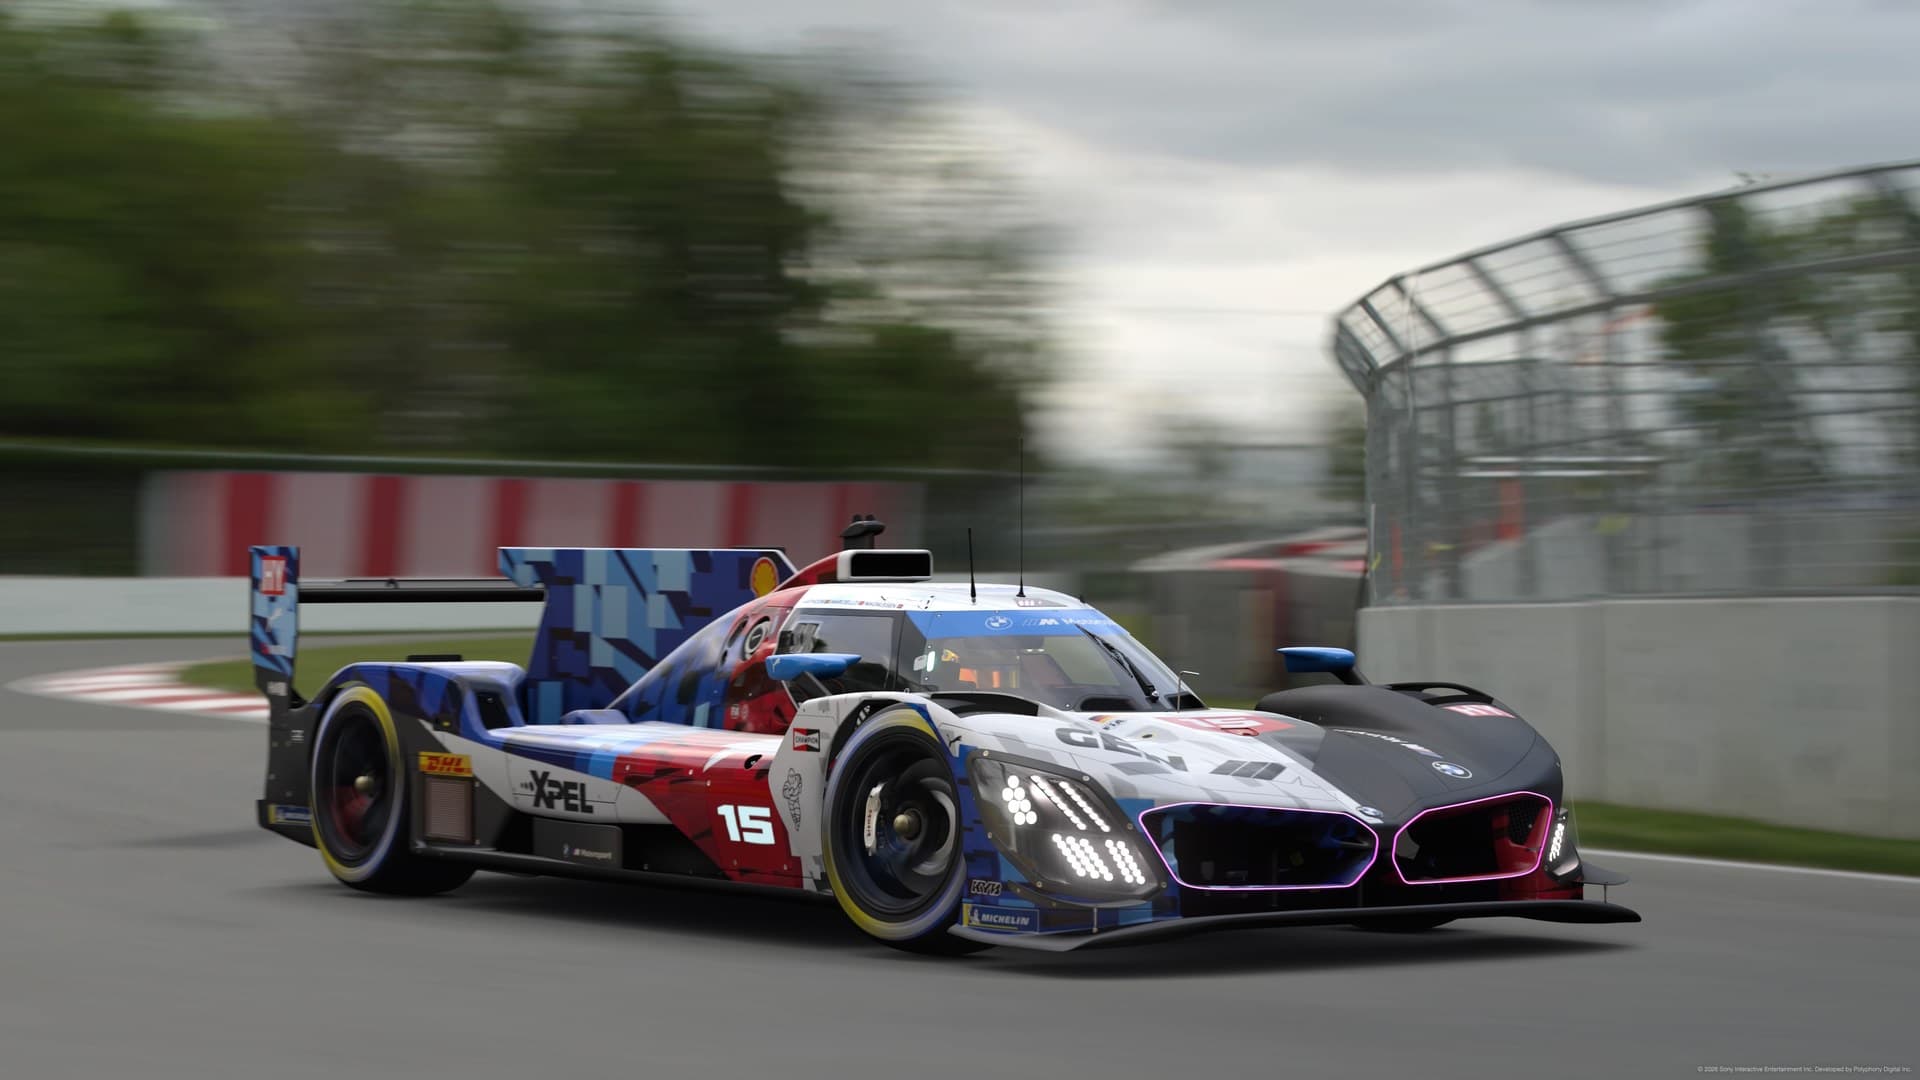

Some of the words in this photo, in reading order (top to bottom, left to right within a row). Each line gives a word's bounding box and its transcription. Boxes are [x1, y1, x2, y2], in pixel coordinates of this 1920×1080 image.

[795, 735, 818, 744] CHAMPION
[426, 756, 464, 773] DHL
[529, 769, 594, 814] XPEL
[716, 804, 776, 845] 15
[981, 913, 1031, 926] MICHELIN
